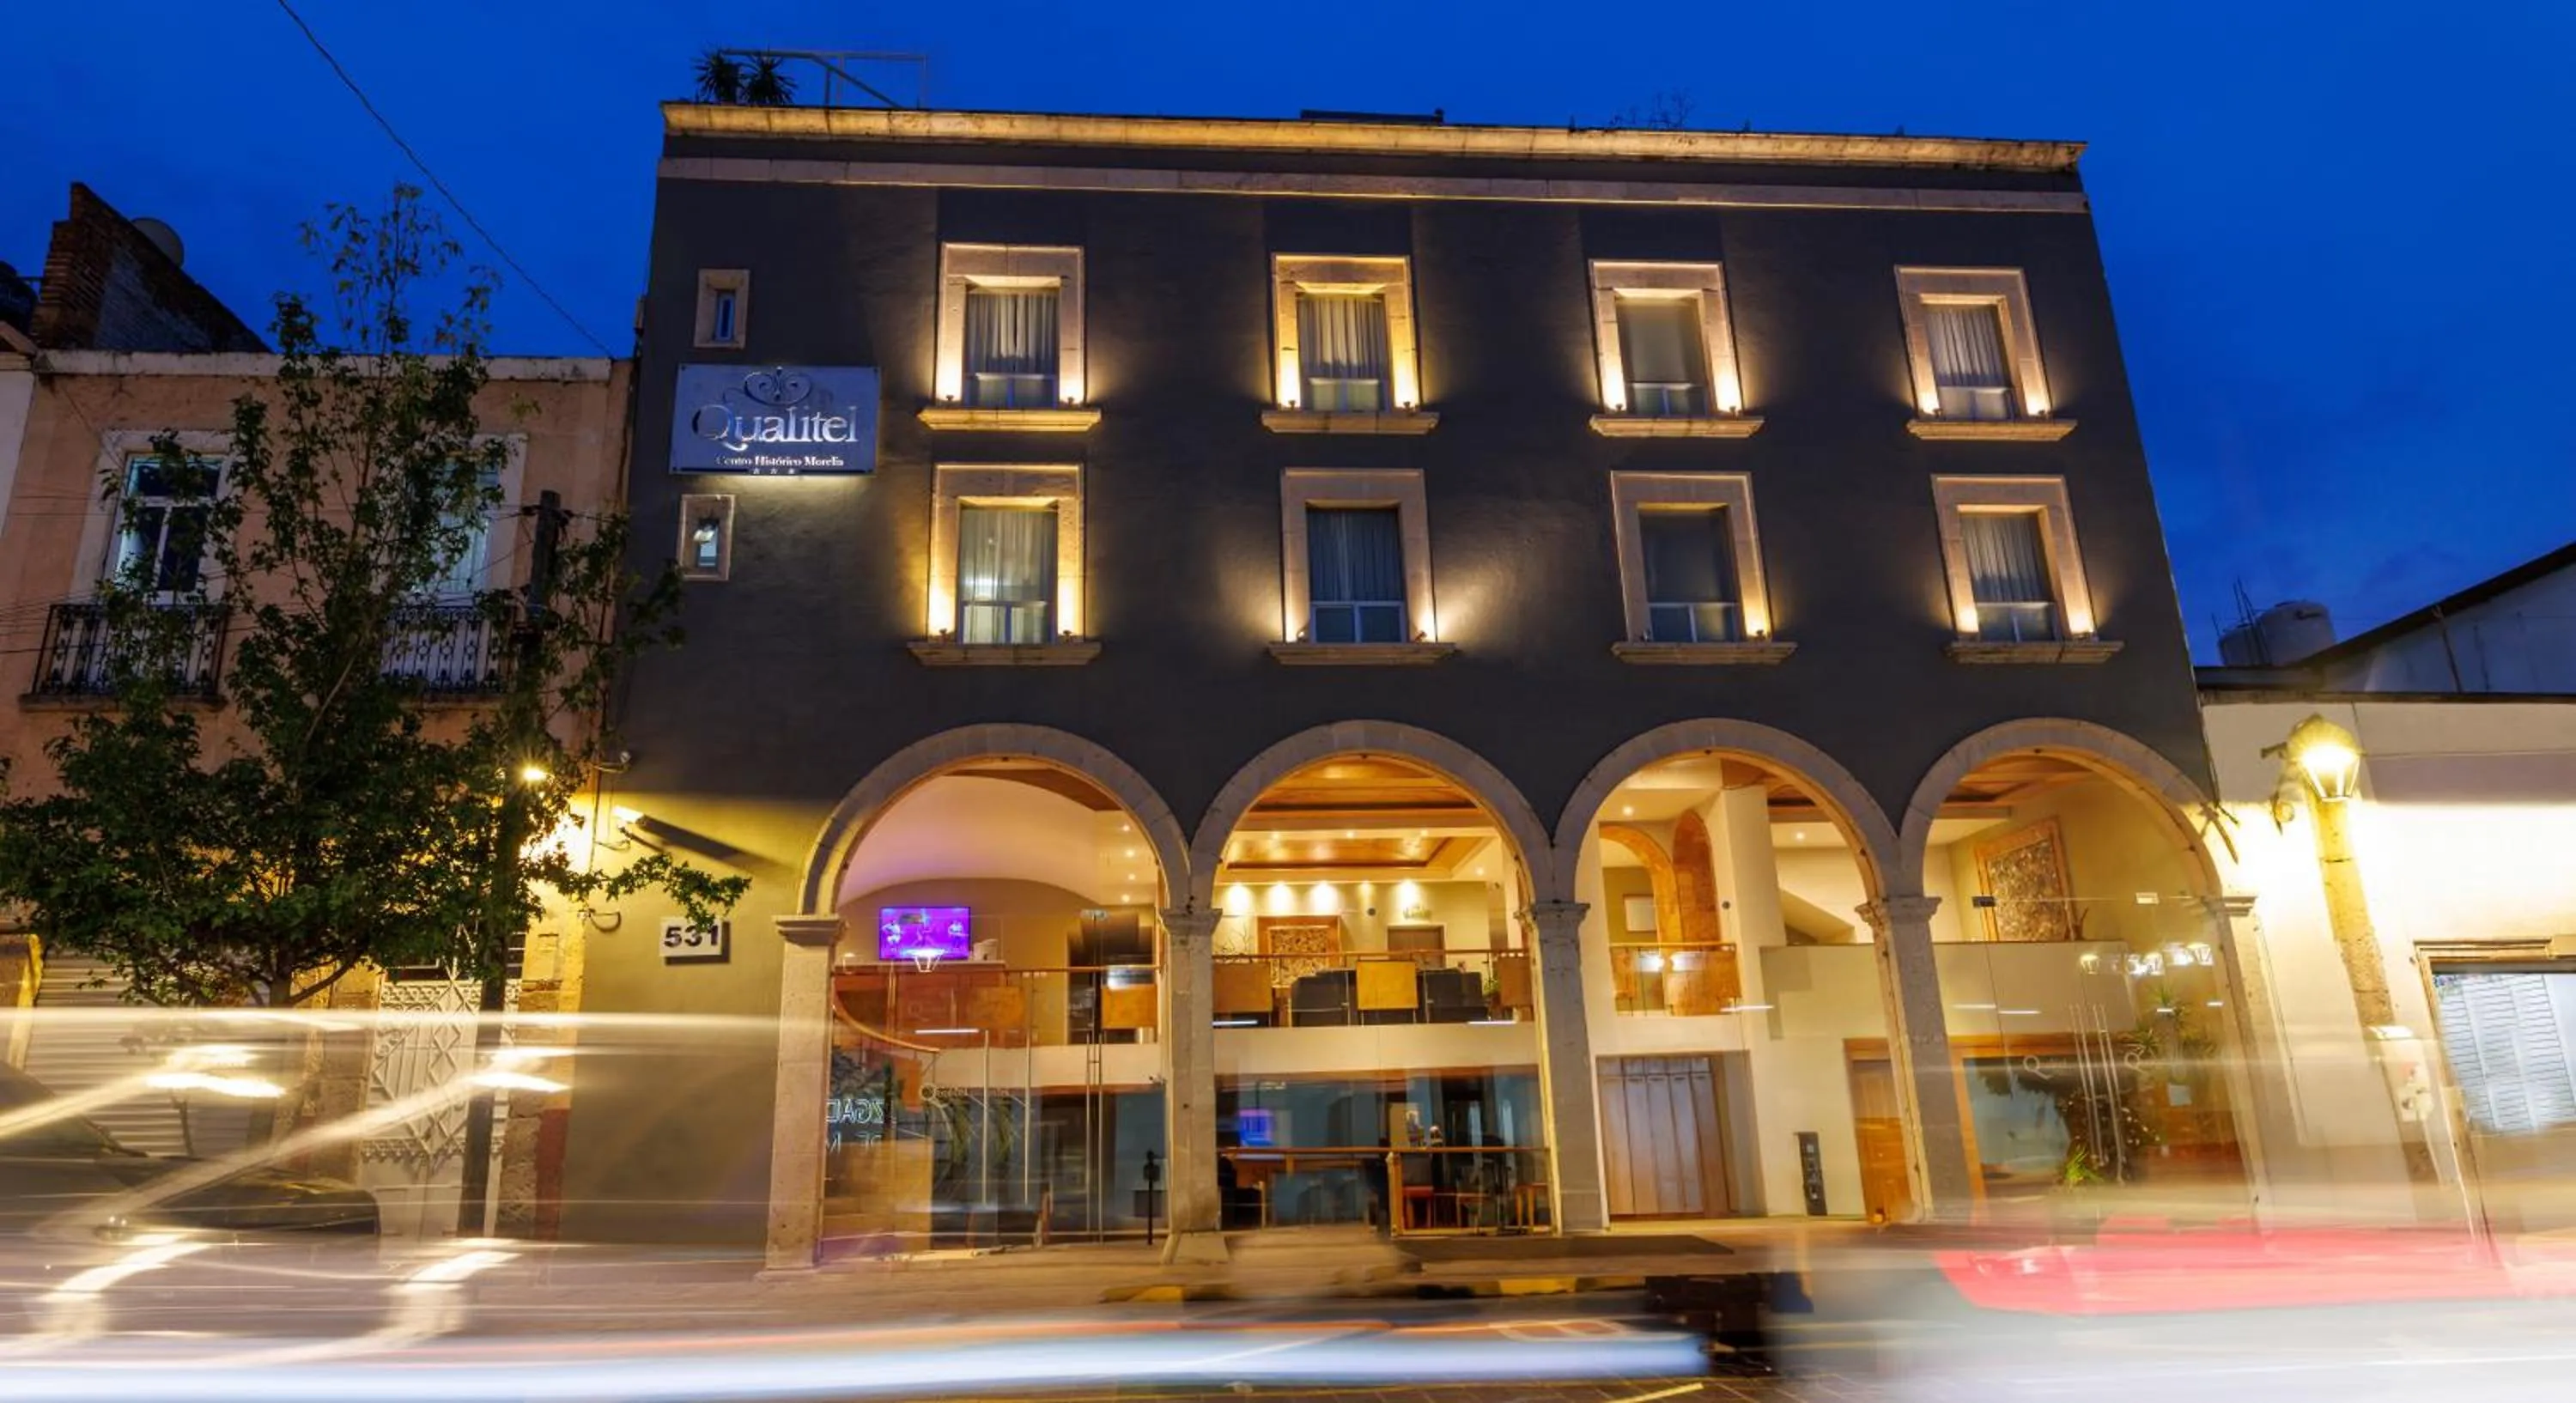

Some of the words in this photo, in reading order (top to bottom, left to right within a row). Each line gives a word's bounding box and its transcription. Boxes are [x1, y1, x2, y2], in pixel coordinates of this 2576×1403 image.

[692, 404, 860, 452] Qualitel
[716, 456, 752, 466] Centro
[754, 455, 801, 466] Histórico
[803, 456, 844, 466] Morelia
[664, 925, 719, 947] 531
